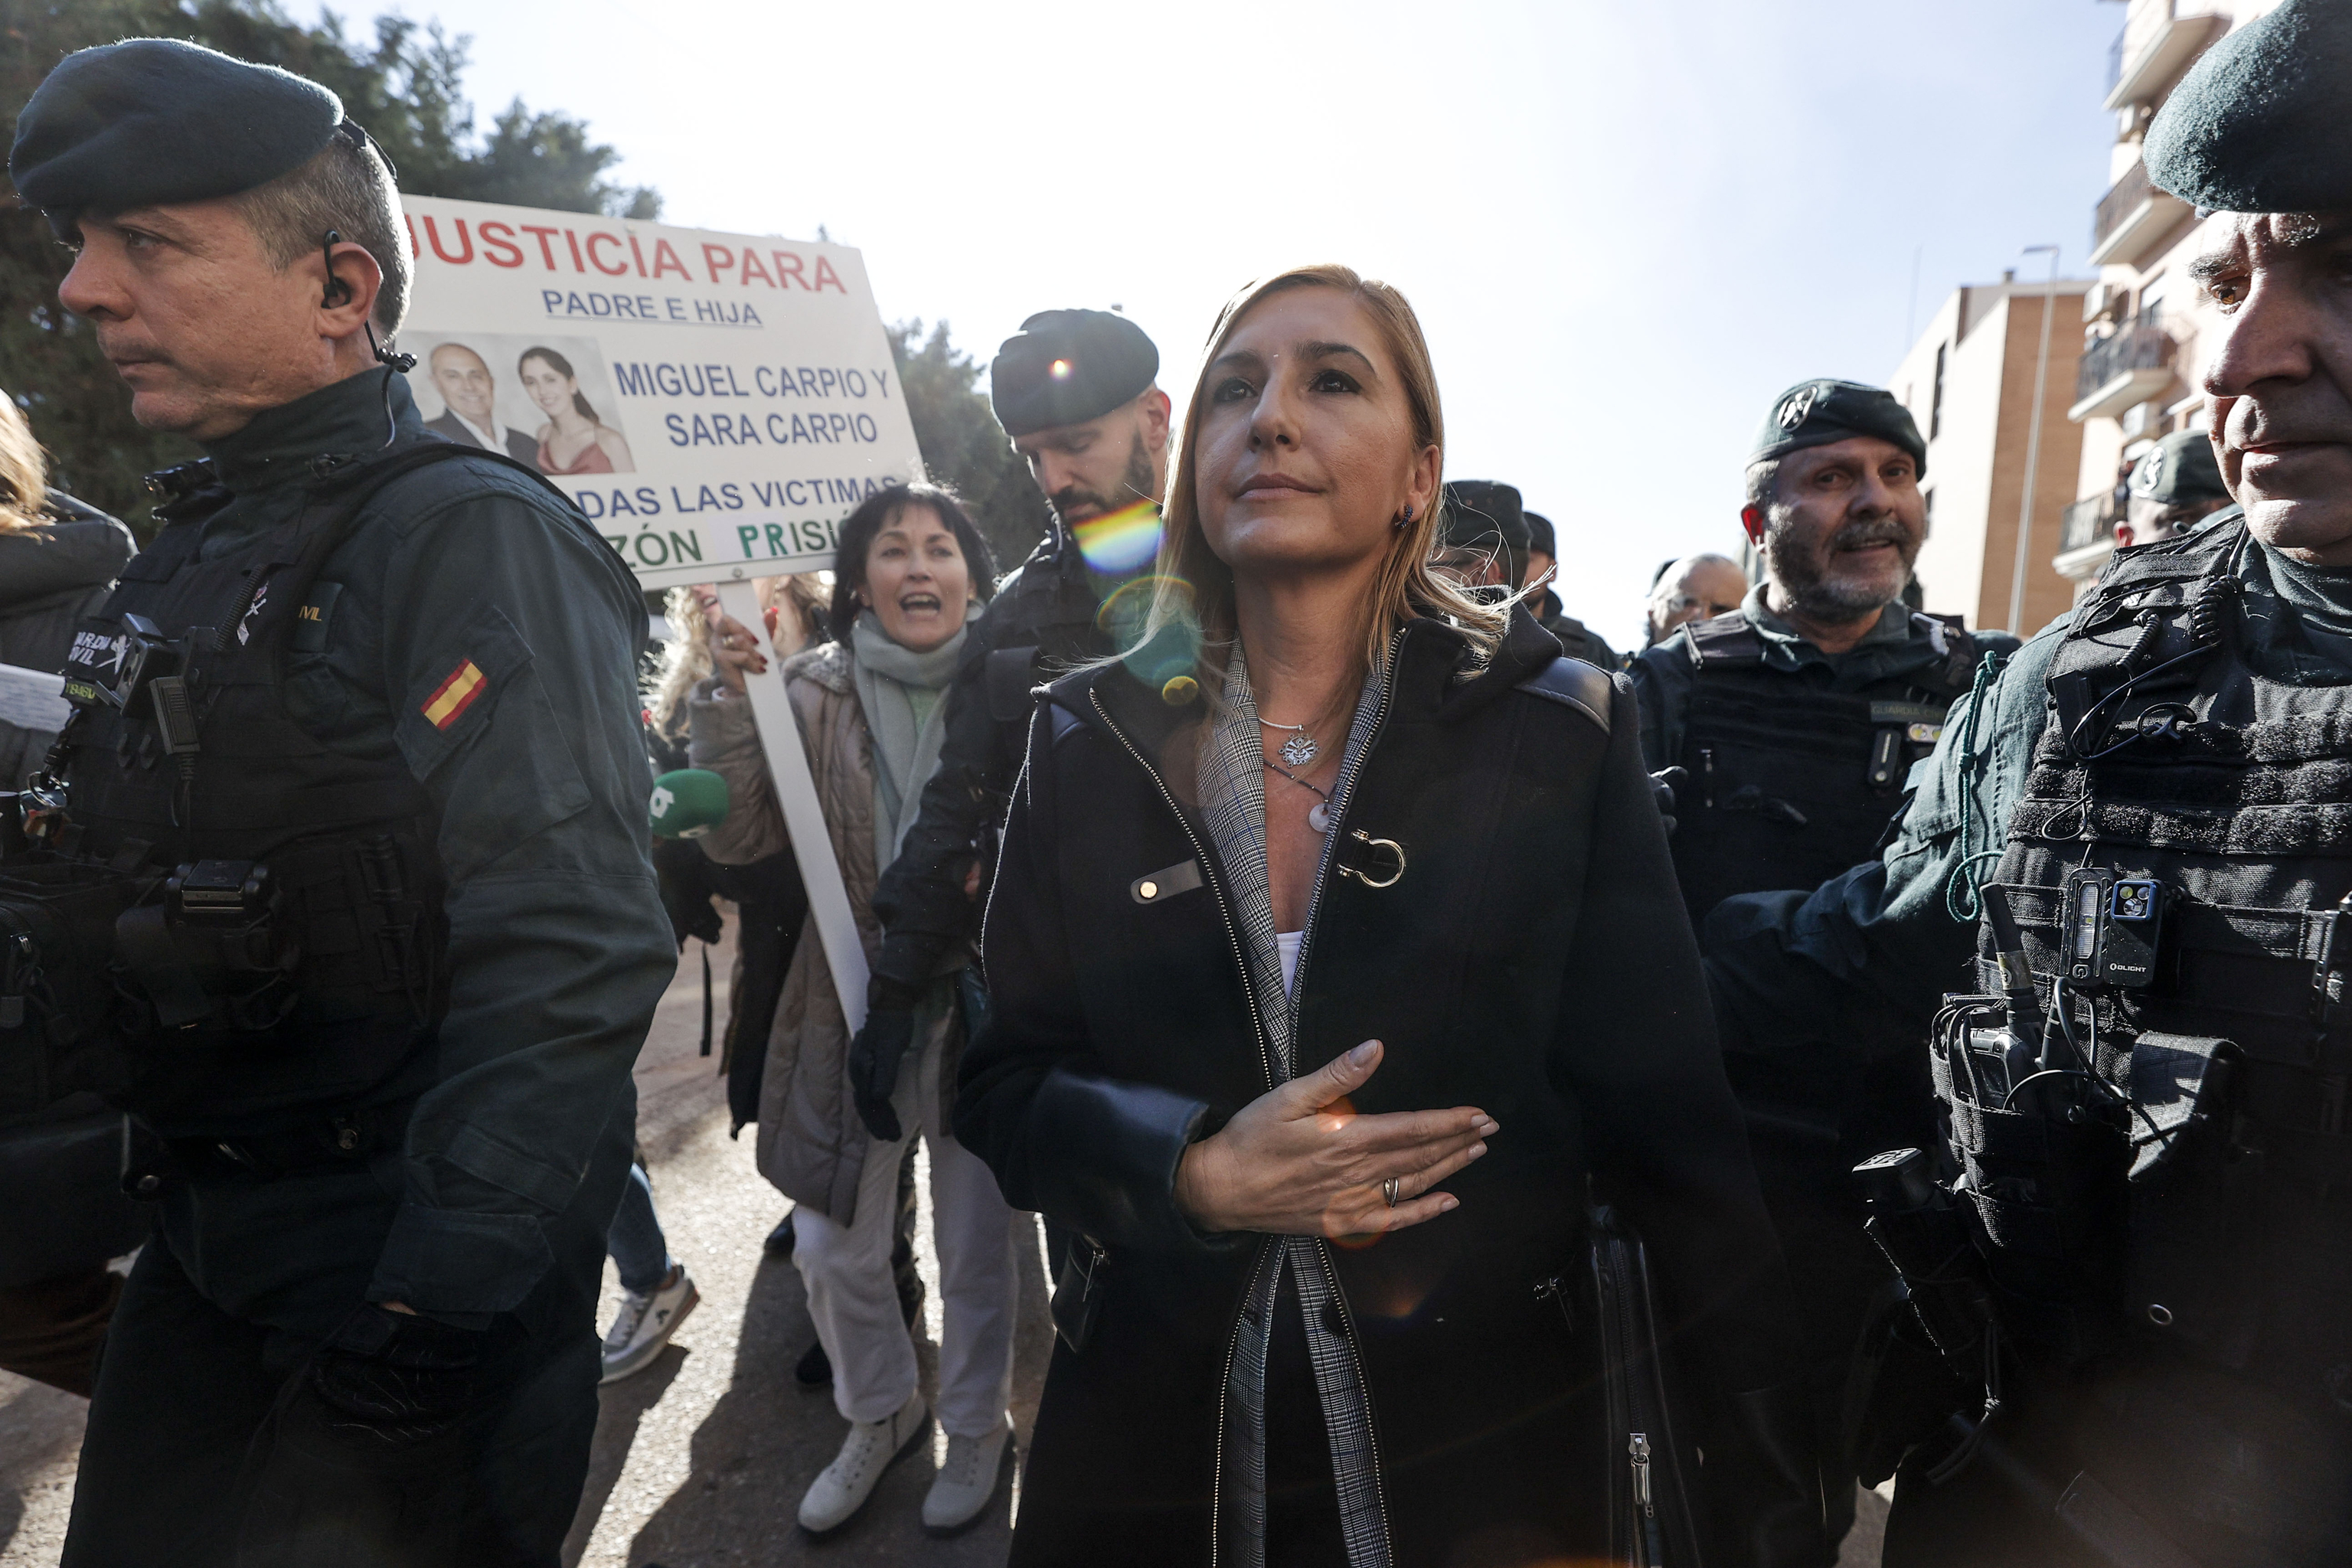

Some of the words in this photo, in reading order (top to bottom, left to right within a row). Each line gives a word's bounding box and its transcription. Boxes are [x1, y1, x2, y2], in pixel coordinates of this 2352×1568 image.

[701, 242, 848, 295] PARA
[541, 289, 658, 319] PADRE
[665, 297, 687, 320] E
[694, 299, 762, 325] HIJA
[613, 362, 750, 397] MIGUEL
[755, 365, 867, 398] CARPIO
[871, 369, 888, 398] Y
[665, 412, 762, 446] SARA
[767, 413, 877, 445] CARPIO
[576, 486, 661, 519] DAS
[669, 483, 743, 513] LAS
[605, 523, 702, 568] ZÓN
[737, 510, 848, 559] PRISI
